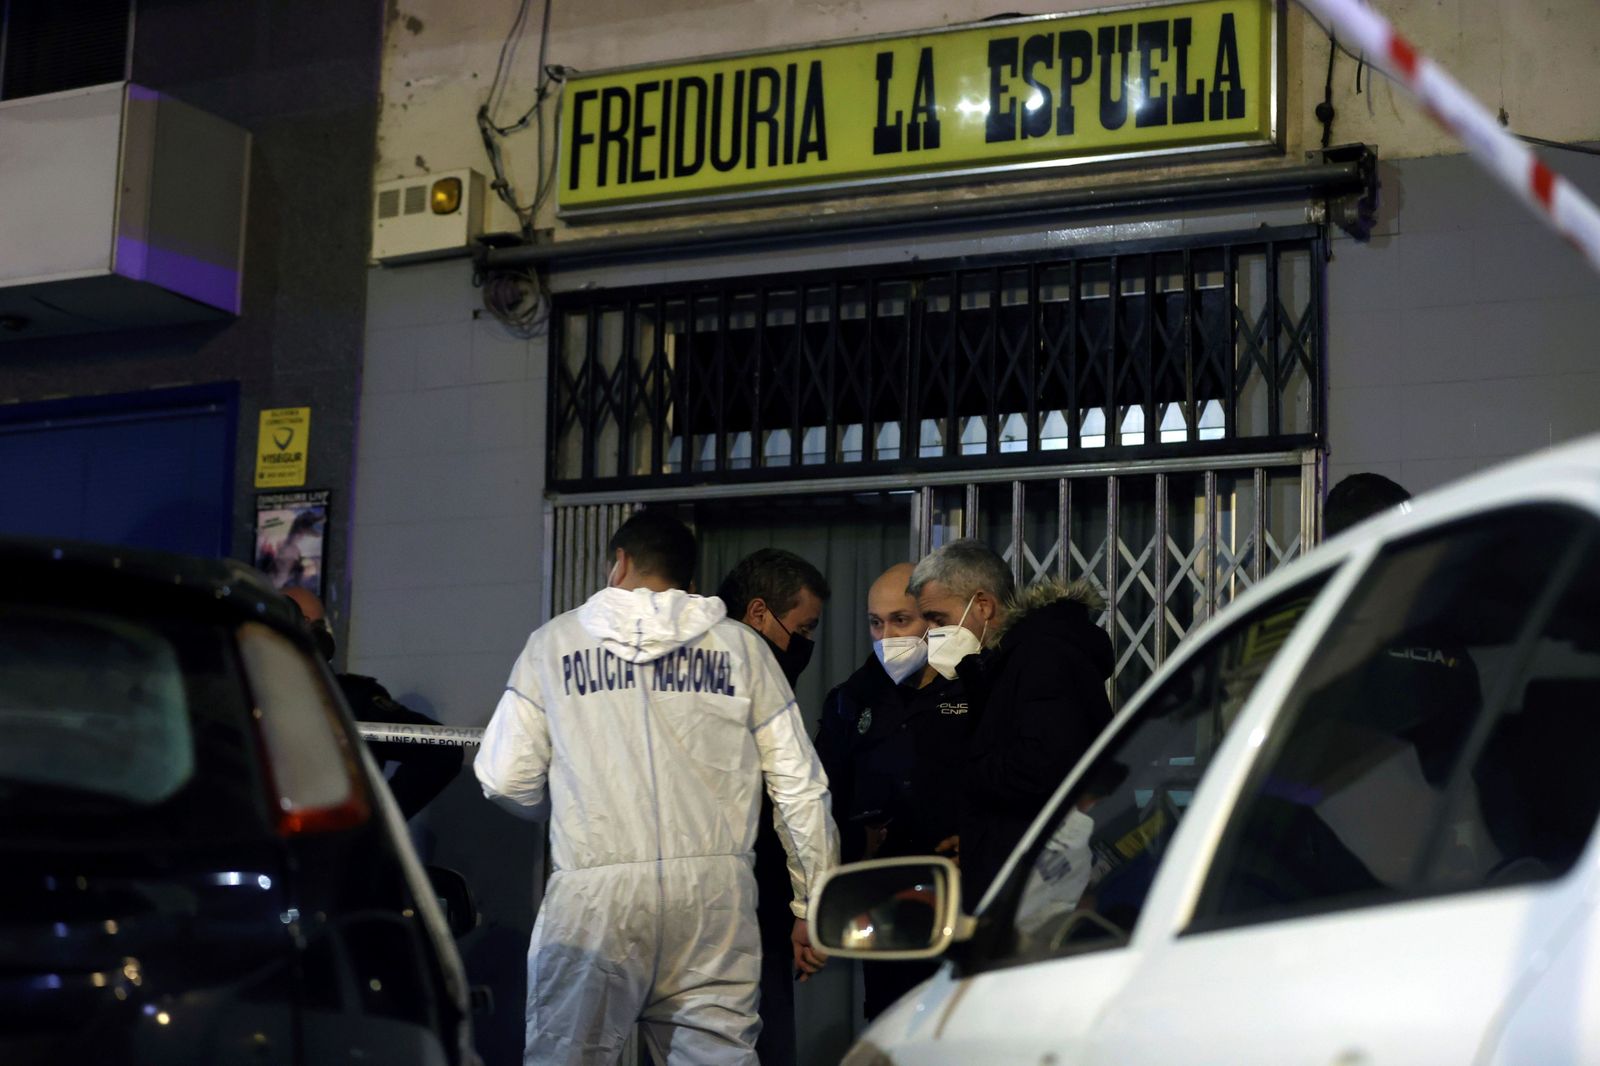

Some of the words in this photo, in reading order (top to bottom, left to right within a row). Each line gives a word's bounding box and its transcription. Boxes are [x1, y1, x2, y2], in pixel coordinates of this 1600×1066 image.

[569, 60, 828, 190] FREIDURIA
[873, 47, 940, 155] LA
[985, 13, 1245, 143] ESPUELA
[562, 647, 636, 696] POLICIA
[651, 646, 736, 697] NACIONAL
